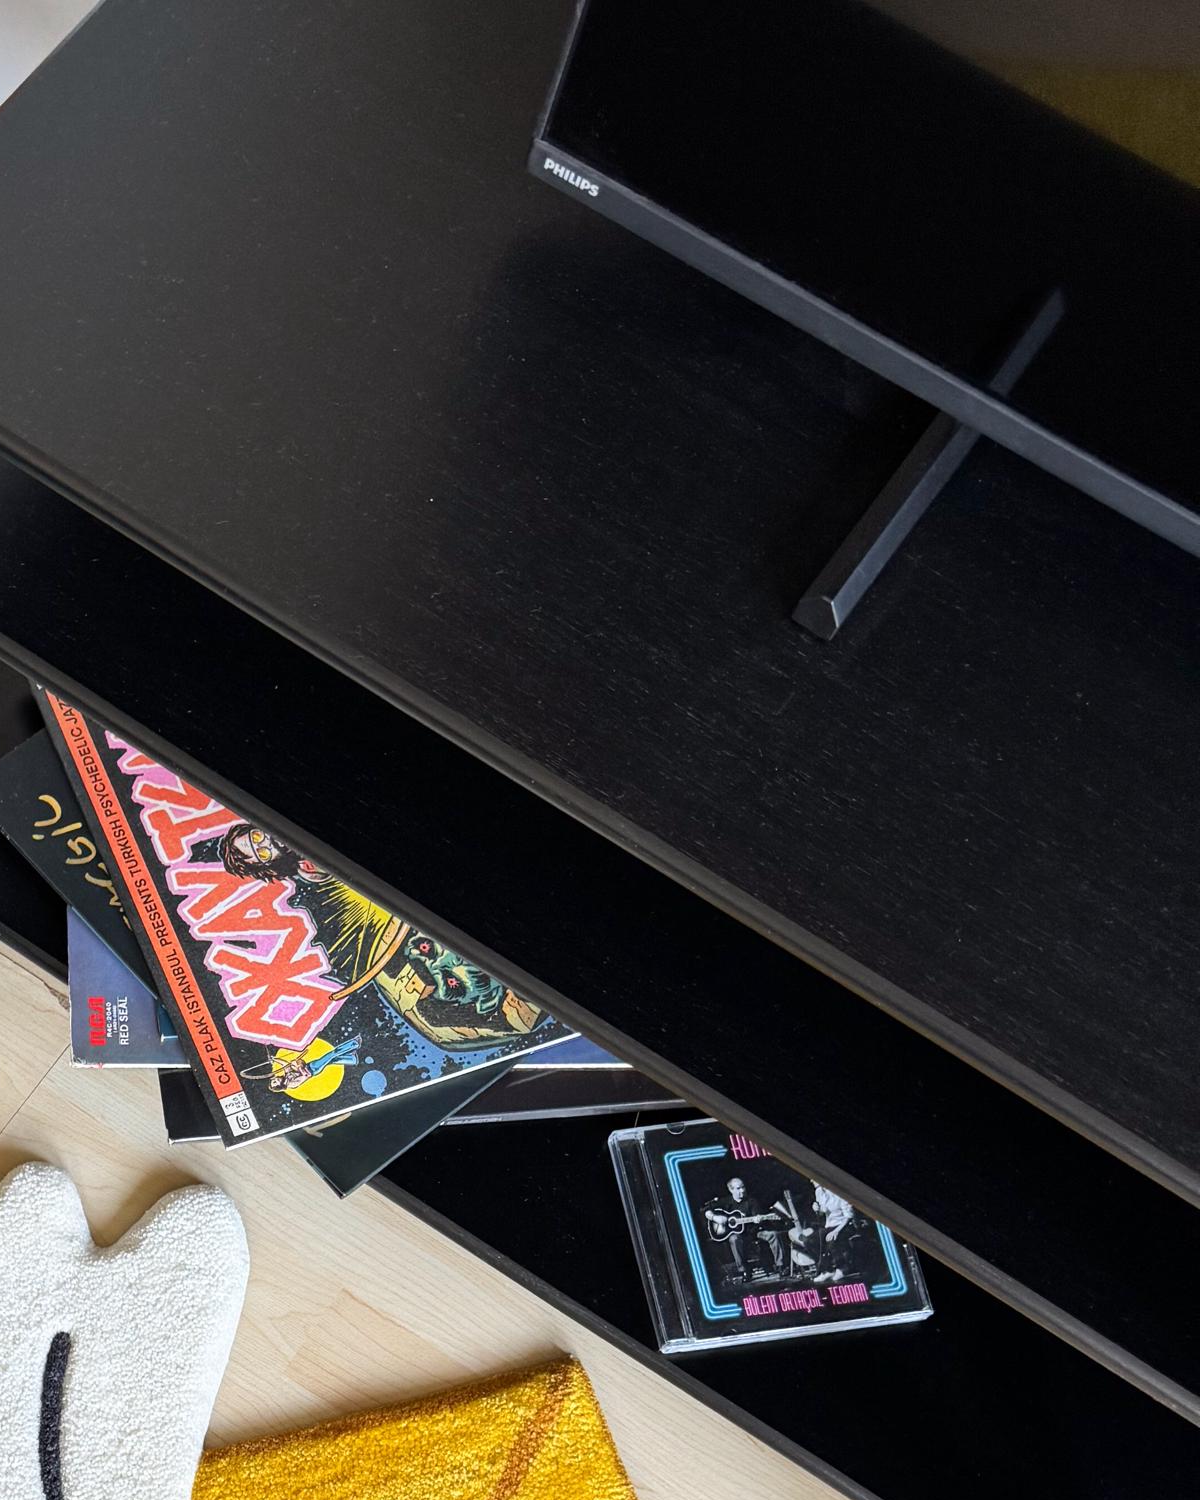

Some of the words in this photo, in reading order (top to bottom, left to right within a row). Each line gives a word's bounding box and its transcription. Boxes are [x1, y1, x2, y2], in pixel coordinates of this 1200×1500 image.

[543, 157, 599, 197] PHILIPS
[70, 727, 117, 818] PSYCHEDELIC
[109, 819, 142, 878] TURKISH
[134, 878, 173, 947] PRESENTS
[165, 862, 347, 1051] OKAY
[87, 996, 107, 1047] RCA
[118, 996, 129, 1021] SEAL
[120, 1024, 129, 1045] RED
[193, 1016, 218, 1053] PLAK
[210, 1054, 231, 1085] CAZ
[743, 1295, 779, 1316] BÜLENT
[828, 1283, 869, 1305] TEOMAN
